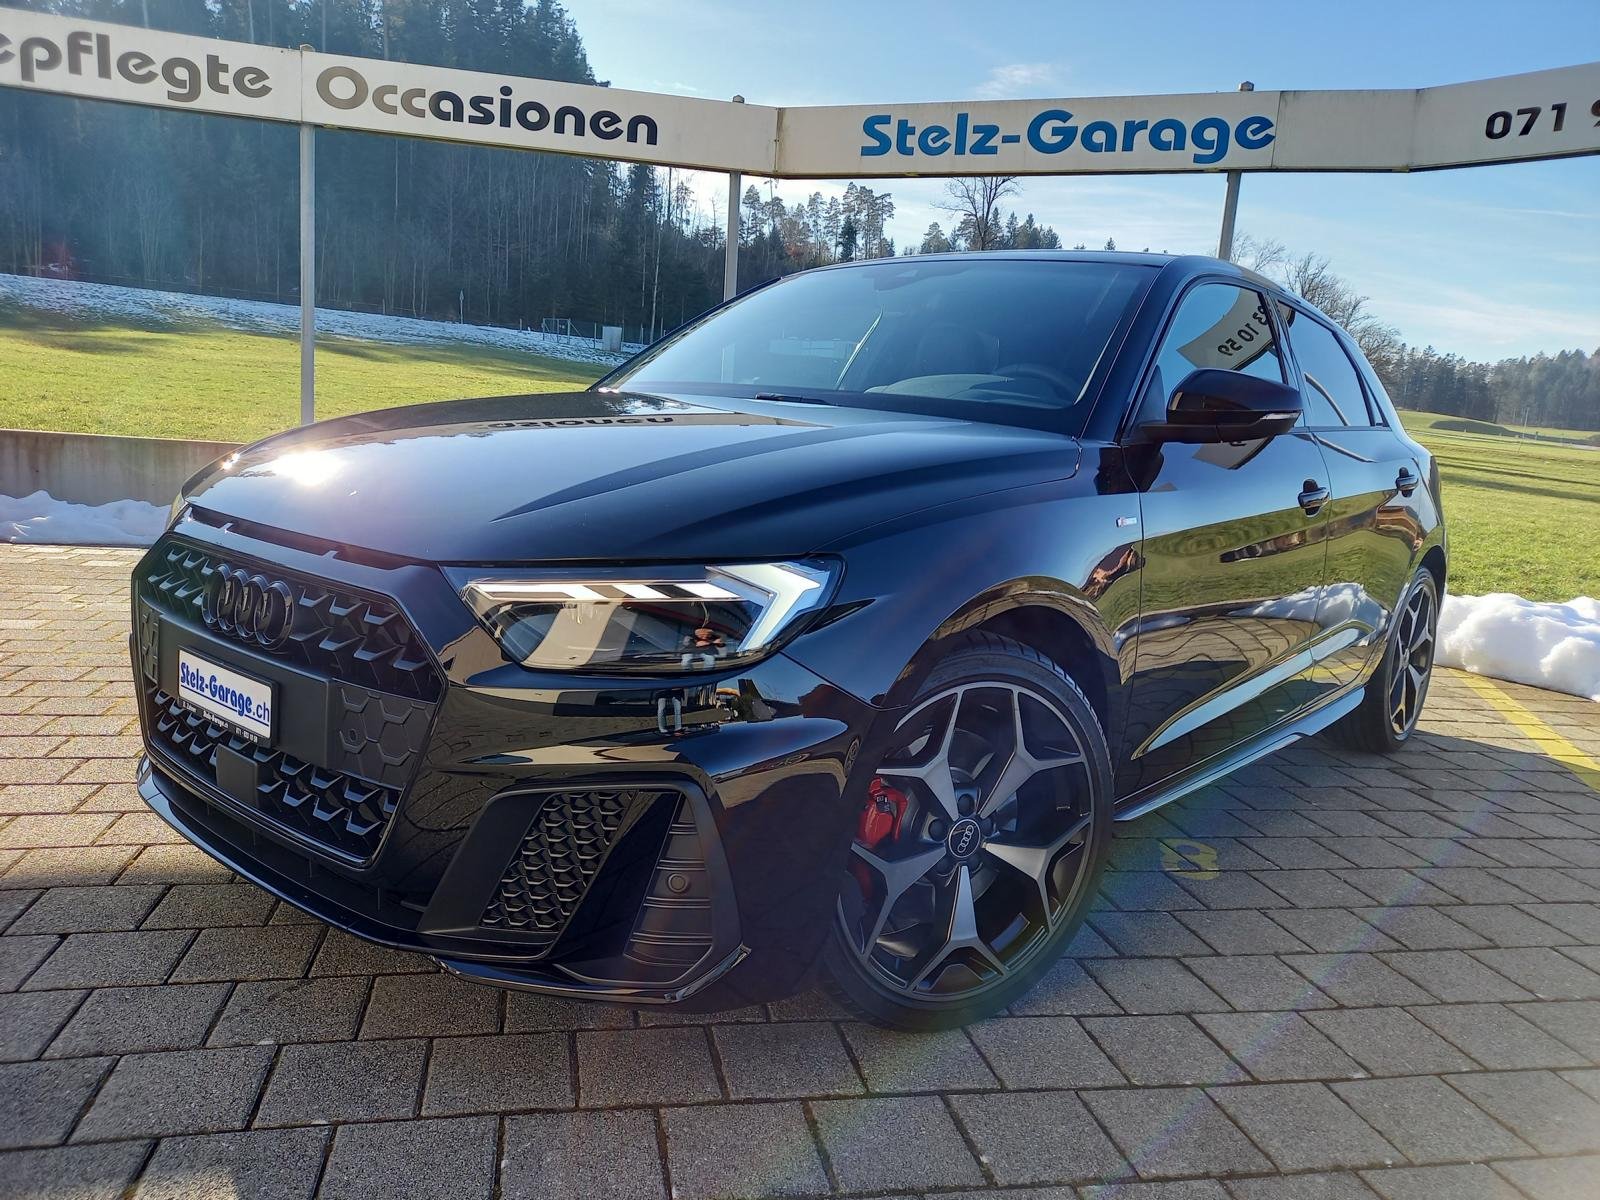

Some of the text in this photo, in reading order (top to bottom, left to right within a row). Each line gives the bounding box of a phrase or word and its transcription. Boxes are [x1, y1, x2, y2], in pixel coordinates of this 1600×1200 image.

[316, 66, 657, 146] Occasionen
[1485, 102, 1568, 139] 071
[861, 109, 1276, 164] Stelz-Garage
[180, 661, 270, 723] Stelz-Garage.ch
